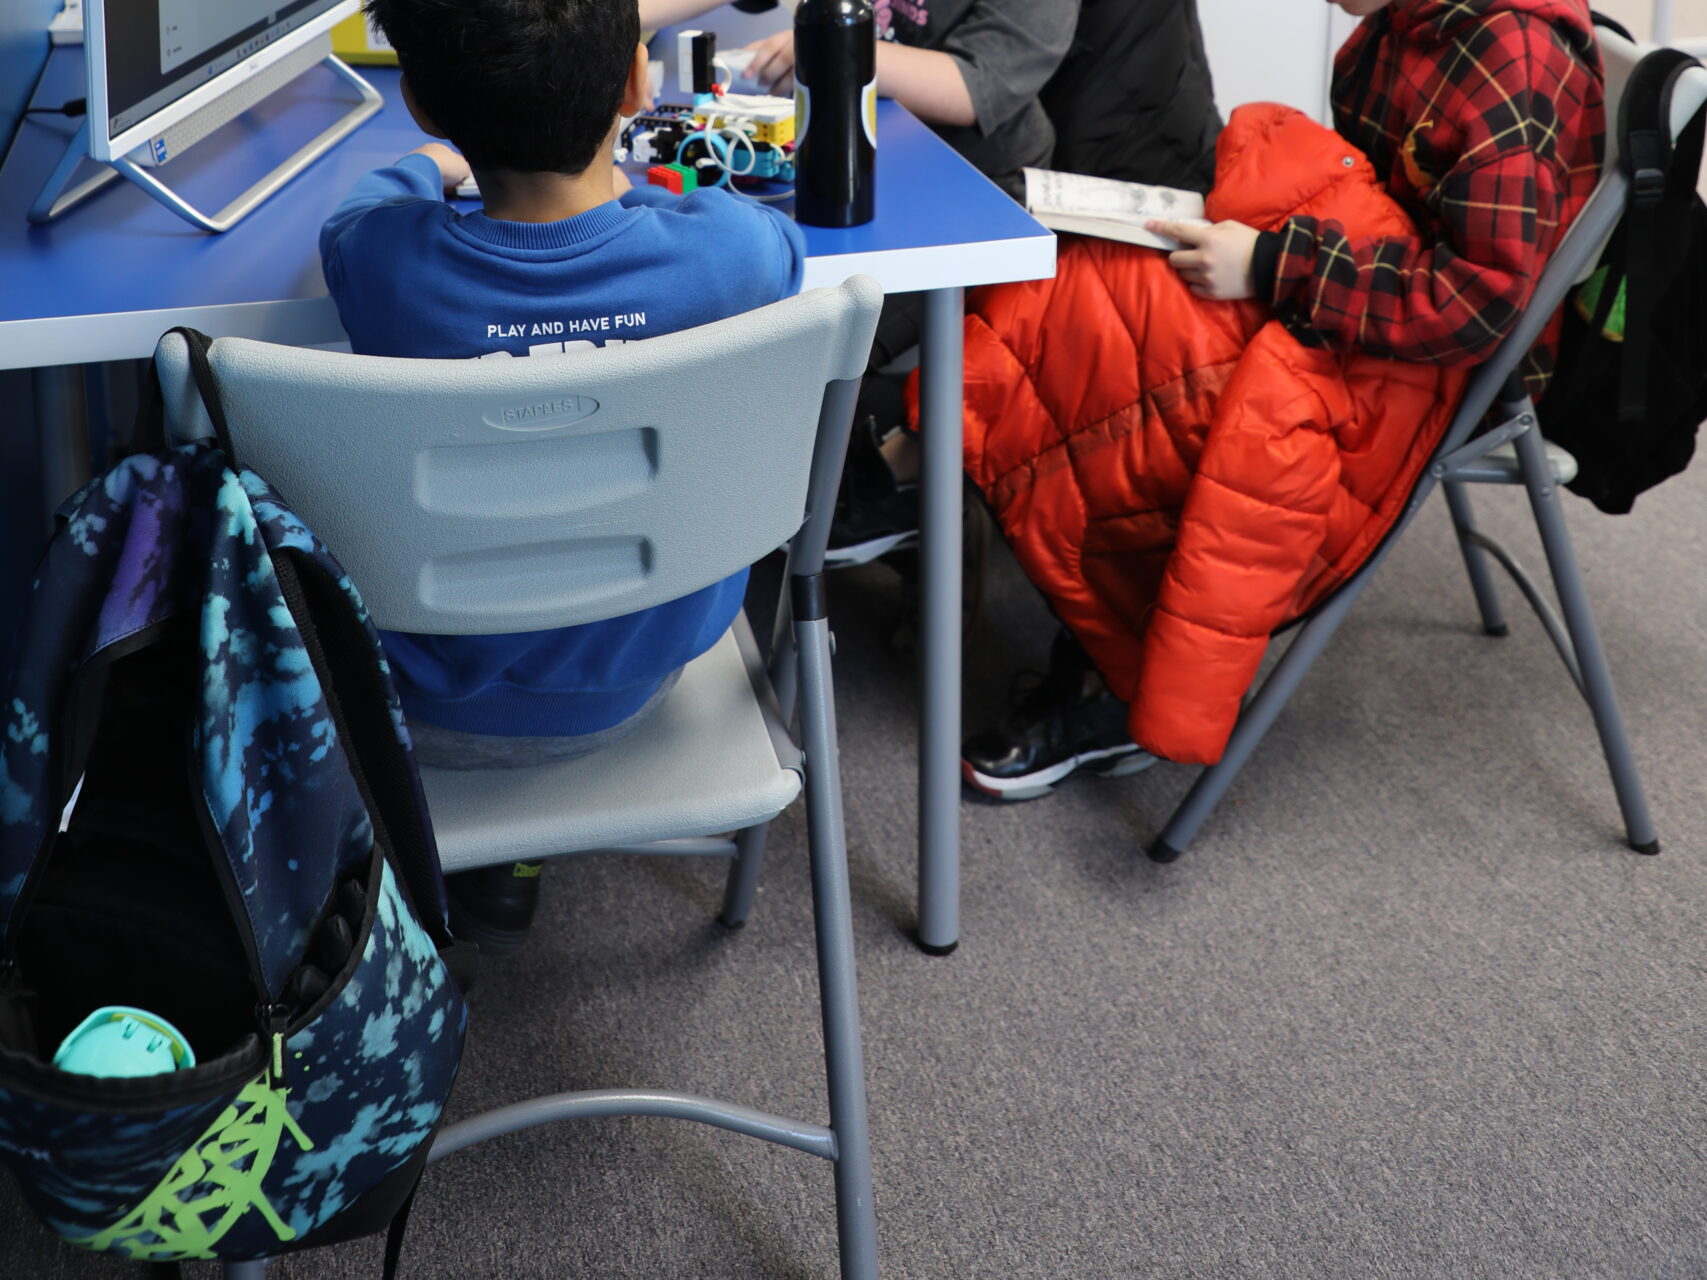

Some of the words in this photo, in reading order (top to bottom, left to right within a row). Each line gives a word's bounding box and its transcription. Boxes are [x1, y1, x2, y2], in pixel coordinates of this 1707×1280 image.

[487, 324, 526, 338] PLAY
[531, 321, 564, 336] AND
[569, 317, 610, 333] HAVE
[615, 312, 646, 328] FUN
[503, 399, 573, 422] STAPLES
